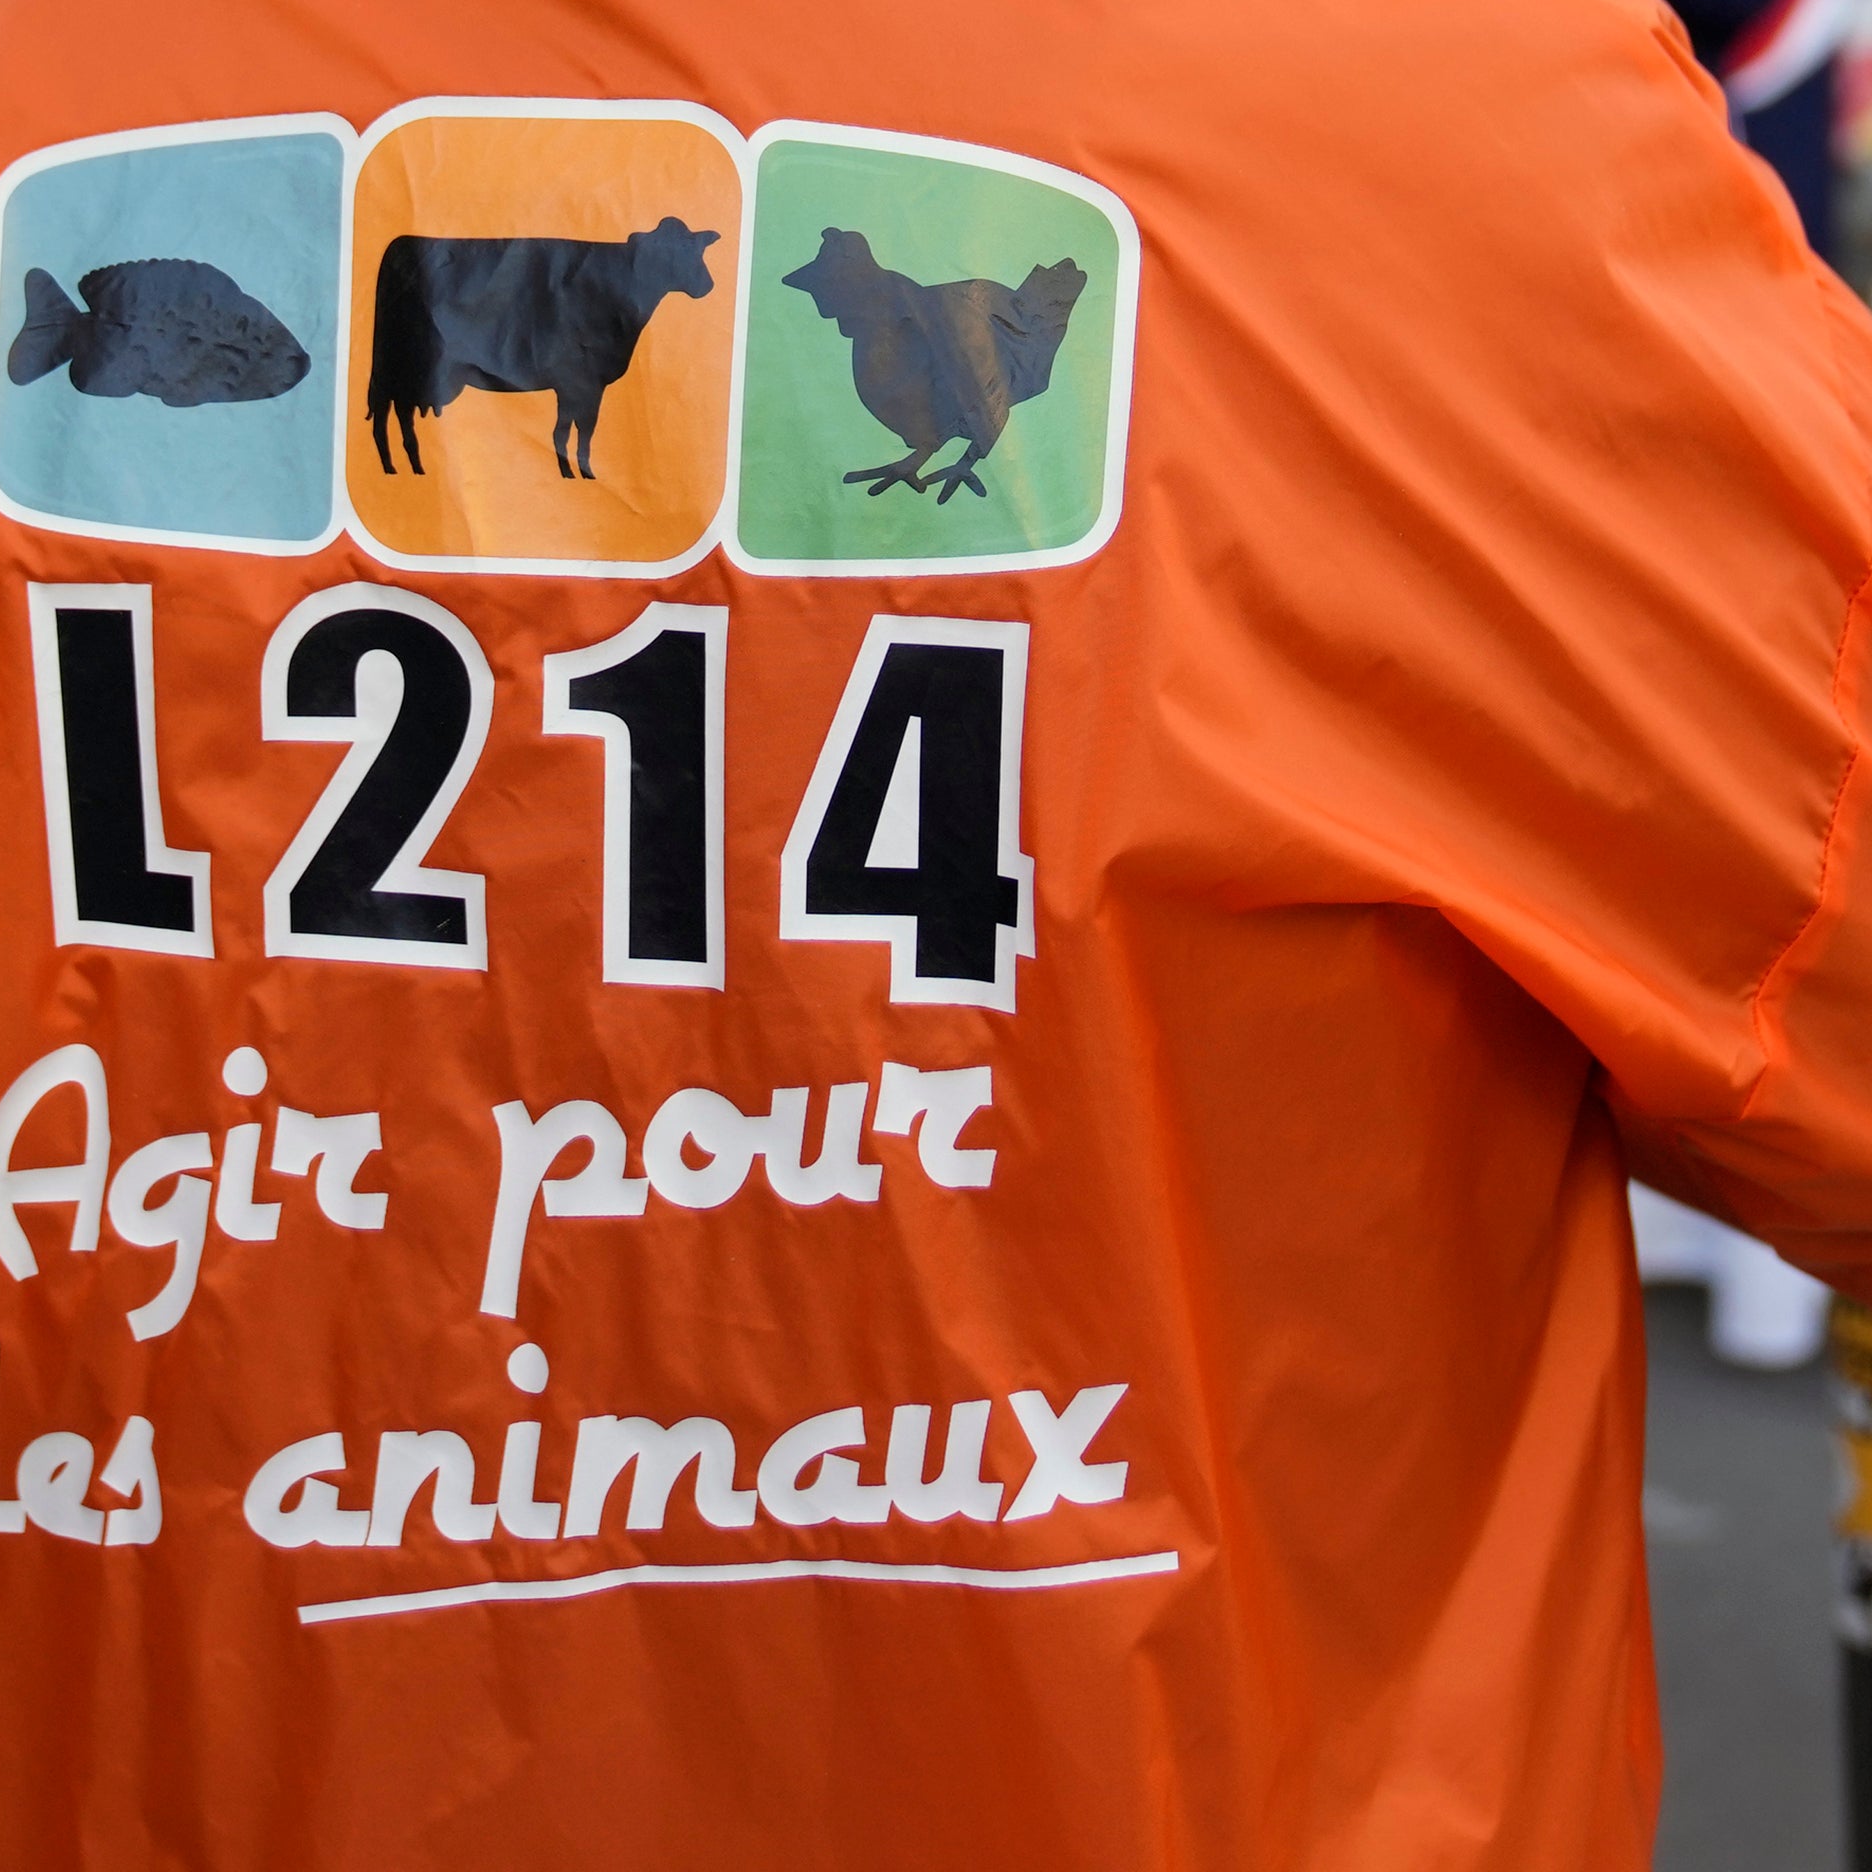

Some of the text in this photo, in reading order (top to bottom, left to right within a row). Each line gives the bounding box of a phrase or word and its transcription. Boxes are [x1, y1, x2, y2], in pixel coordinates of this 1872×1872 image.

[27, 580, 1035, 1014] L214
[480, 1060, 998, 1319] pour
[243, 1341, 1130, 1548] animaux
